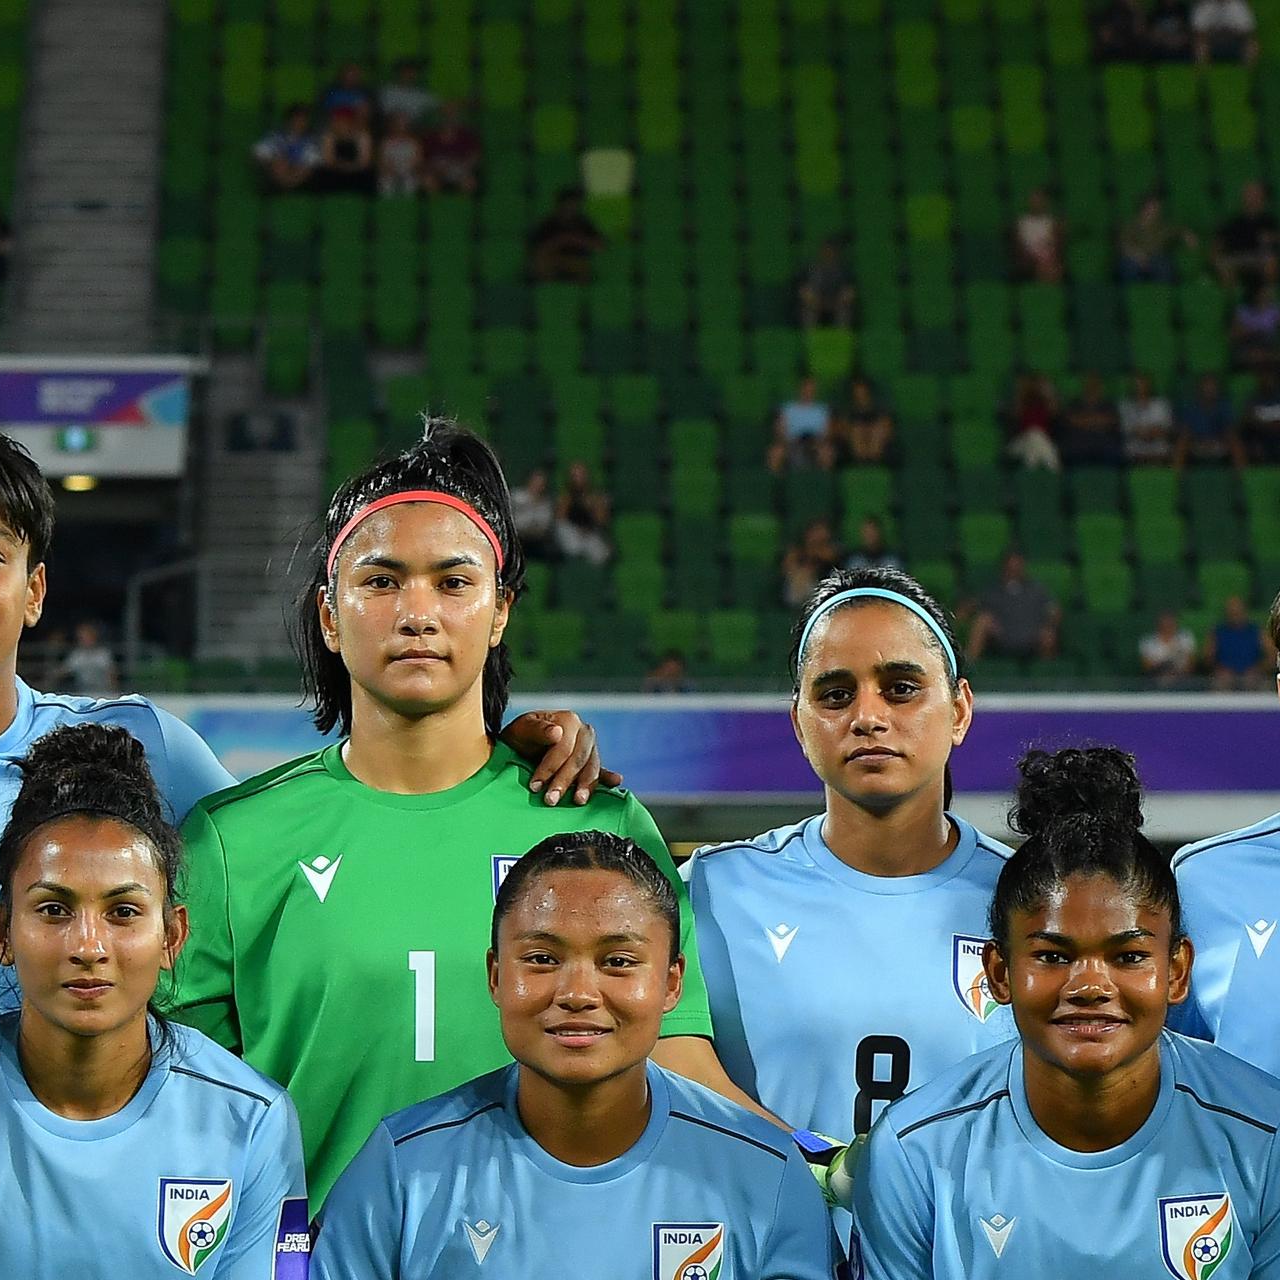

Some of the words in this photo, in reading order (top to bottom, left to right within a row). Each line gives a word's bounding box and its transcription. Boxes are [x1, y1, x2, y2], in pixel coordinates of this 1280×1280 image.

[962, 944, 983, 956] IND
[408, 950, 435, 1062] 1
[854, 1034, 911, 1136] 8
[169, 1188, 210, 1201] INDIA
[1170, 1205, 1210, 1219] INDIA
[663, 1233, 703, 1245] INDIA
